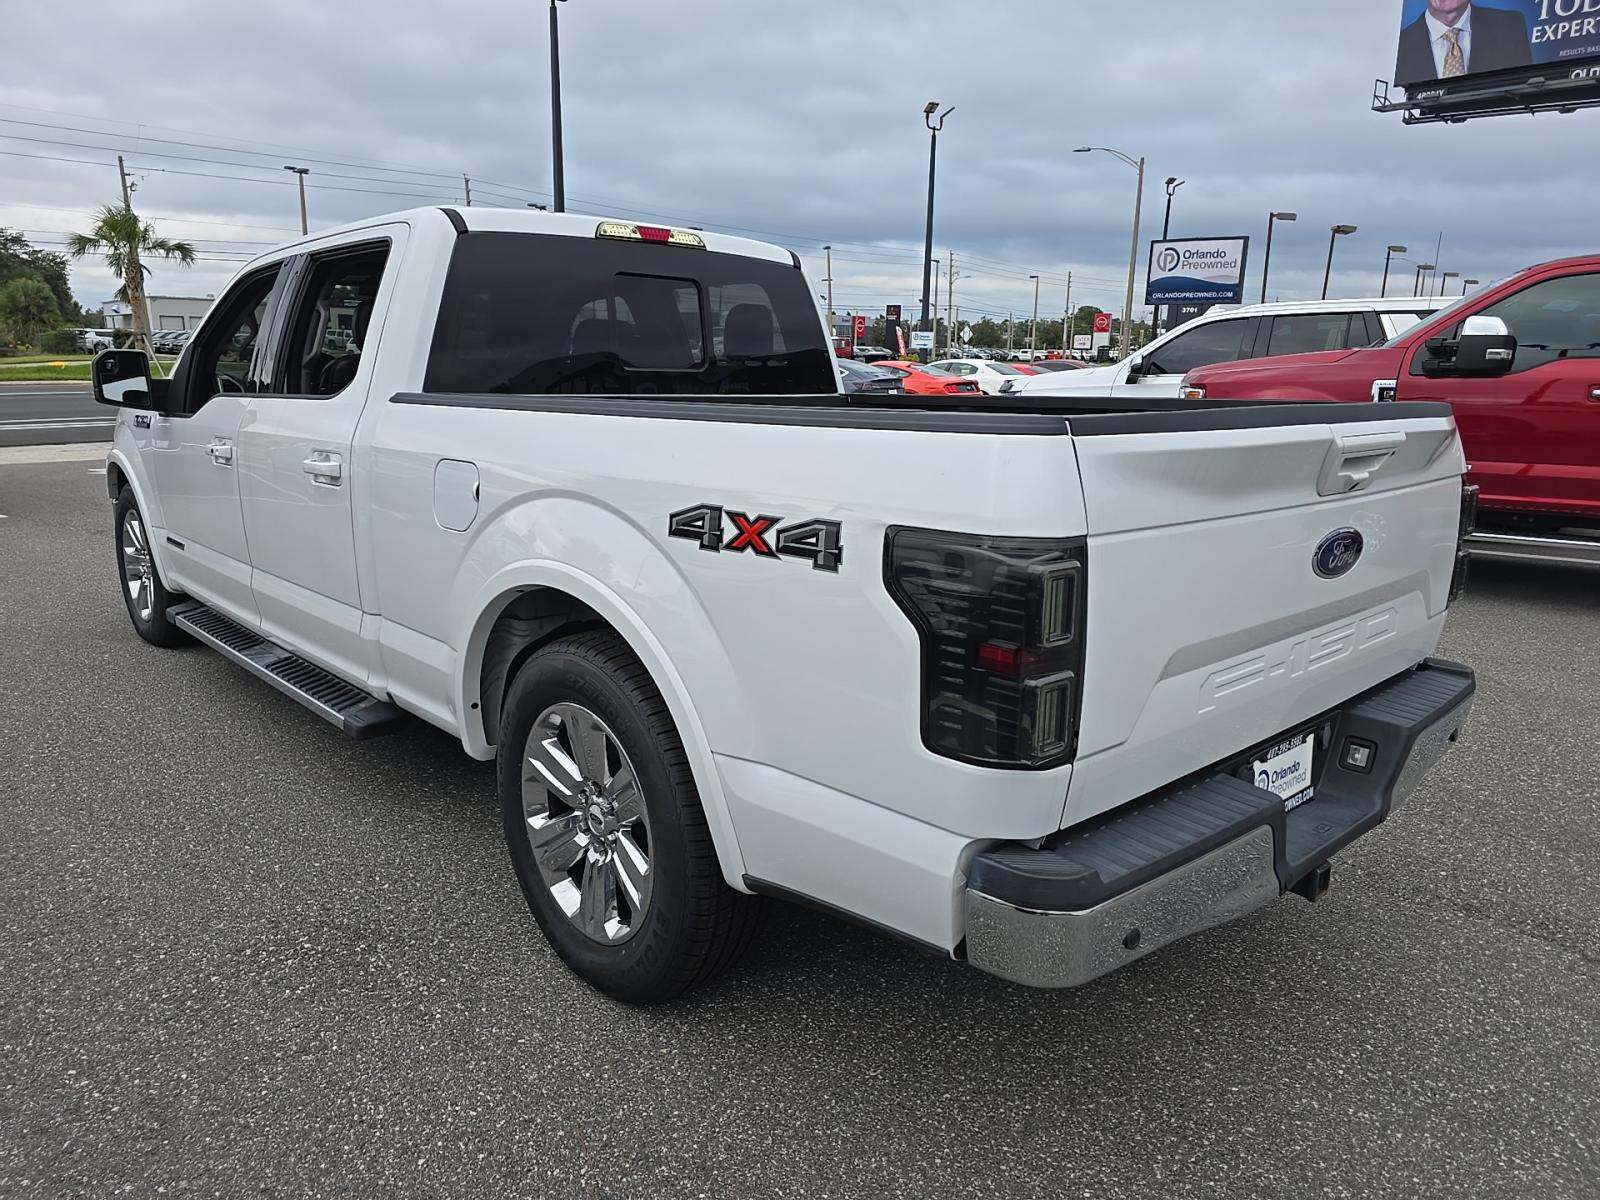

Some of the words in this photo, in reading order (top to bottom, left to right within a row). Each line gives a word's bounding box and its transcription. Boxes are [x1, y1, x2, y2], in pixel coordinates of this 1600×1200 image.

[1183, 249, 1226, 259] Orlando
[1181, 258, 1237, 270] Preowned
[1152, 291, 1233, 299] ORLANDOPREOWNED.COM
[1329, 538, 1358, 569] Ford
[1197, 606, 1400, 714] F-150
[1271, 760, 1301, 784] Orlando
